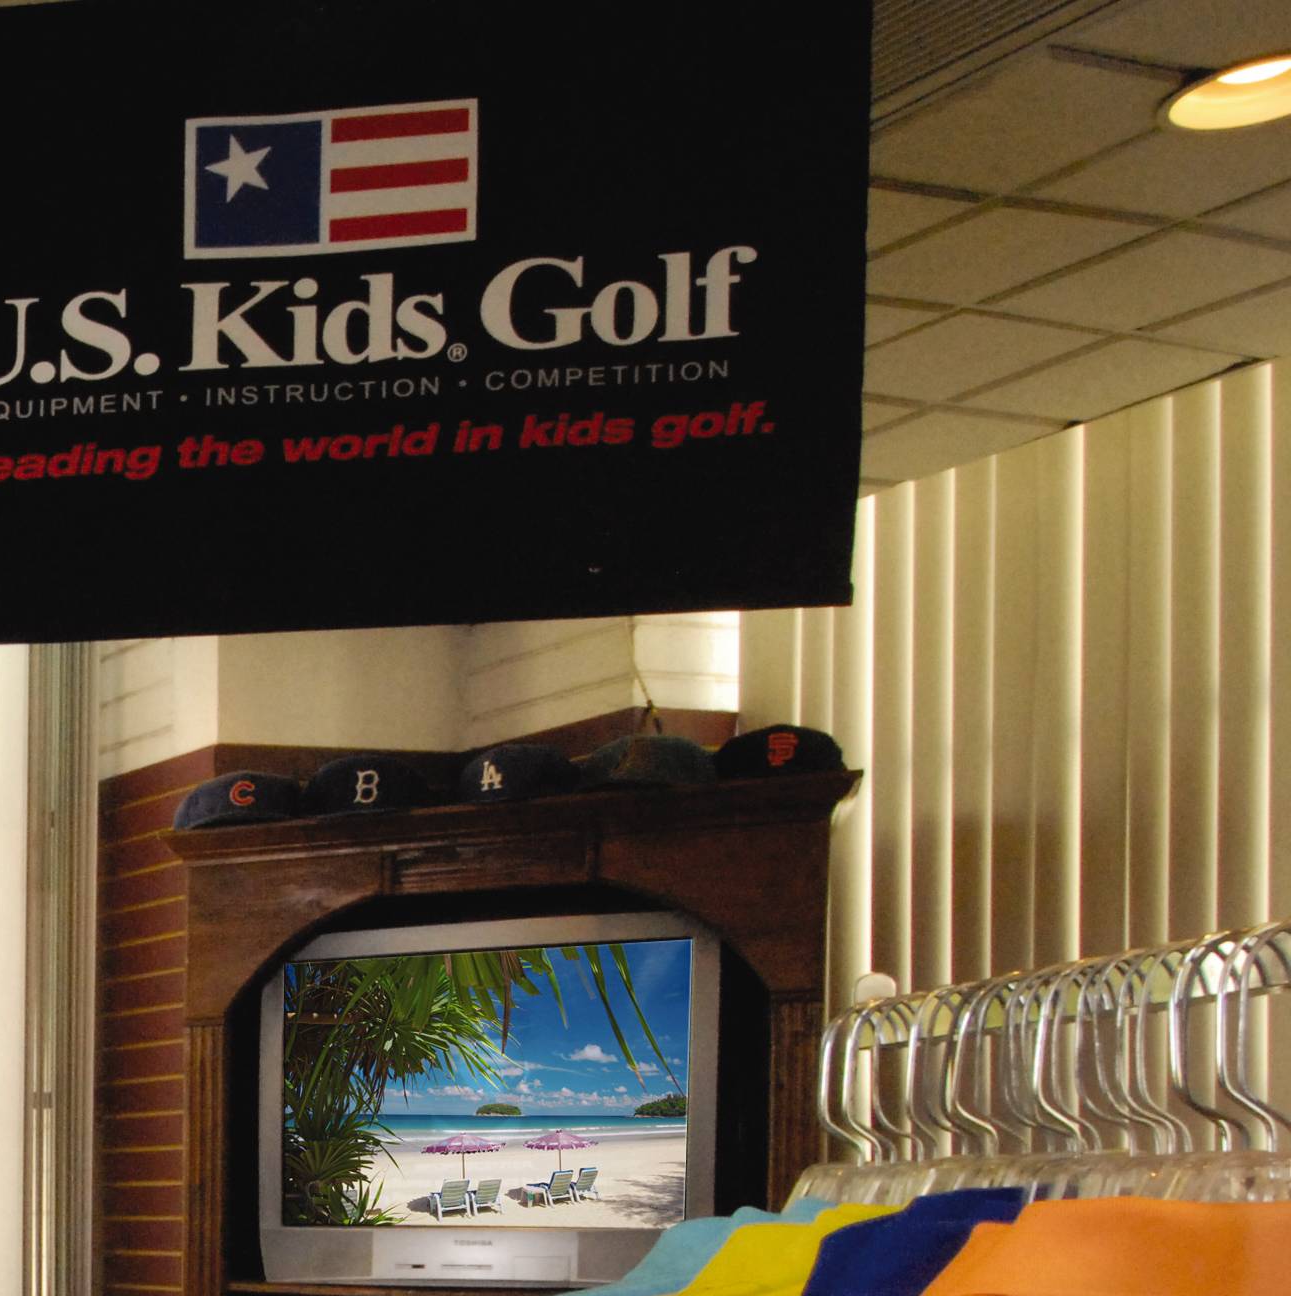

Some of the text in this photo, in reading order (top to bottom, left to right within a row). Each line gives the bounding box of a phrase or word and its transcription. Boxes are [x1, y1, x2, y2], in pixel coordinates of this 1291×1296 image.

[479, 245, 758, 351] Golf
[205, 374, 440, 407] INSTRUCTION
[484, 359, 729, 391] COMPETITION
[177, 434, 265, 469] the
[281, 421, 440, 462] world
[452, 419, 504, 453] in
[518, 410, 636, 449] kids
[650, 399, 776, 449] golf.
[228, 780, 256, 806] C
[352, 769, 380, 804] B
